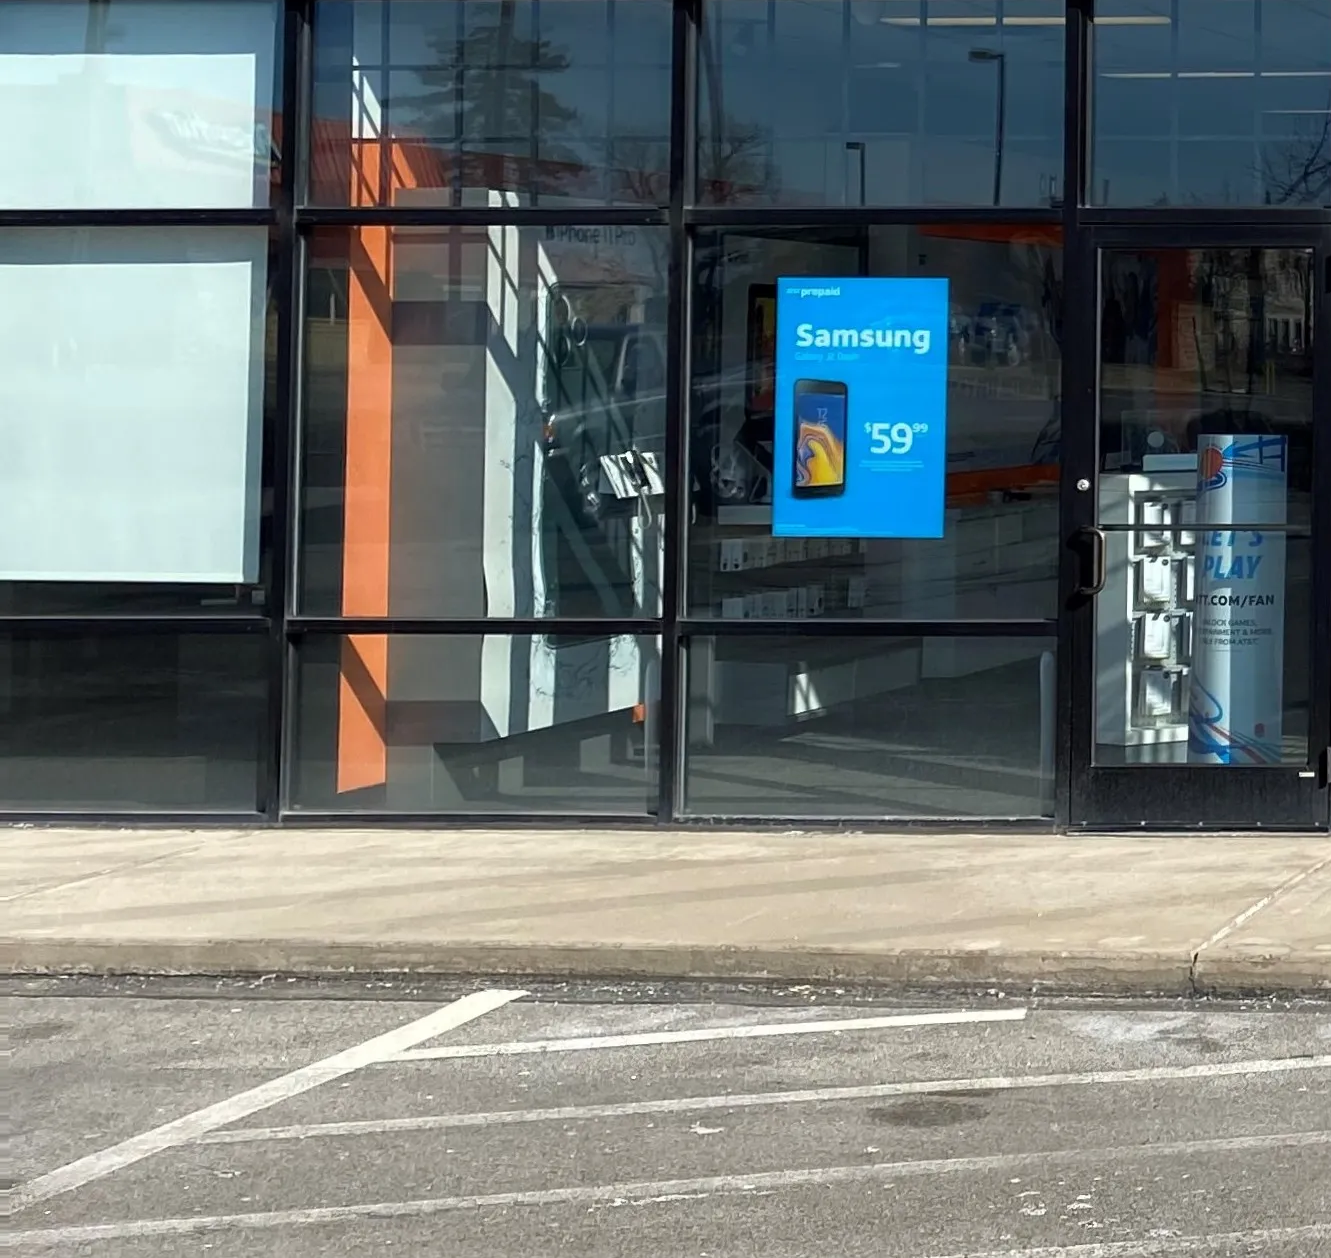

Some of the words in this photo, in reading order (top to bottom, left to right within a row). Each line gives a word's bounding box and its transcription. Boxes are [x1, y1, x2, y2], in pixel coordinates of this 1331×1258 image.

[801, 287, 840, 298] prepaid
[796, 323, 931, 355] Samsung
[1203, 555, 1263, 579] PLAY
